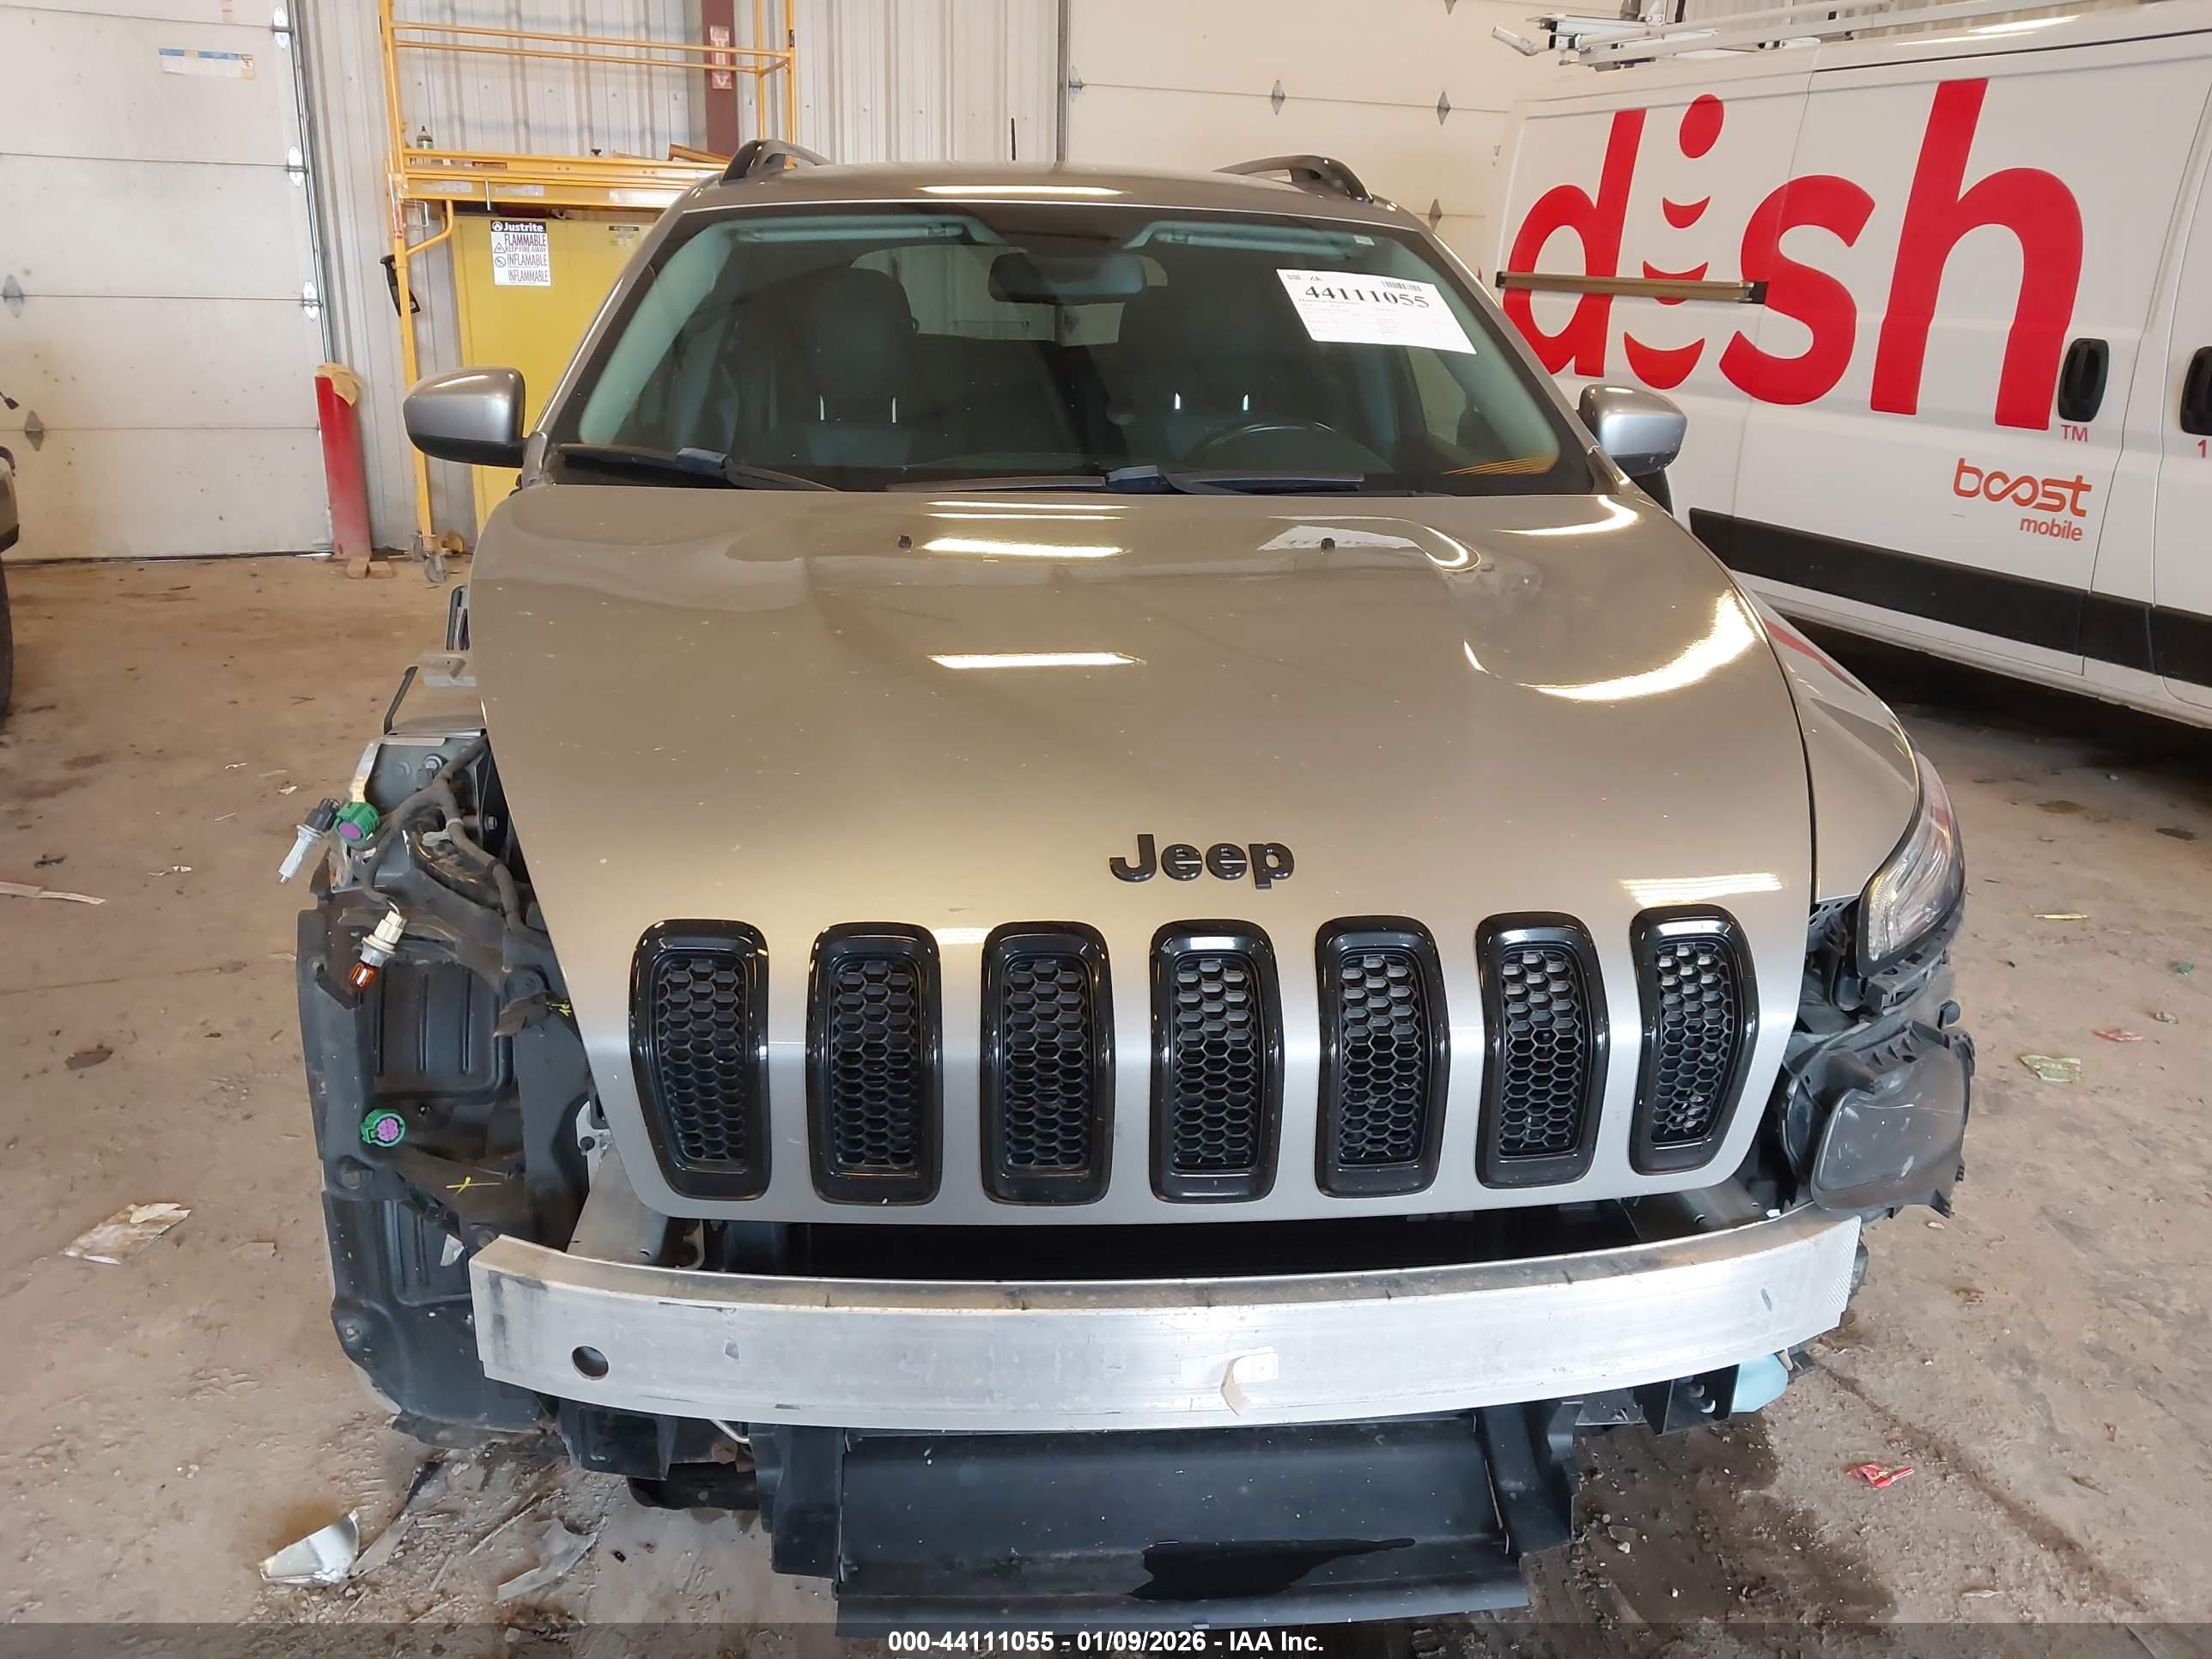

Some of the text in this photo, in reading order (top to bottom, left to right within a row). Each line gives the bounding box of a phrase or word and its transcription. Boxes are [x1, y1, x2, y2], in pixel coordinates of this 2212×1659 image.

[503, 222, 544, 232] Justrite
[504, 234, 546, 246] FLAMMABLE
[1503, 78, 2083, 431] dish
[1304, 286, 1430, 308] 44111055
[2060, 424, 2088, 442] TM
[1953, 457, 2093, 518] boost
[2019, 517, 2083, 541] mobile
[1109, 833, 1295, 890] Jeep
